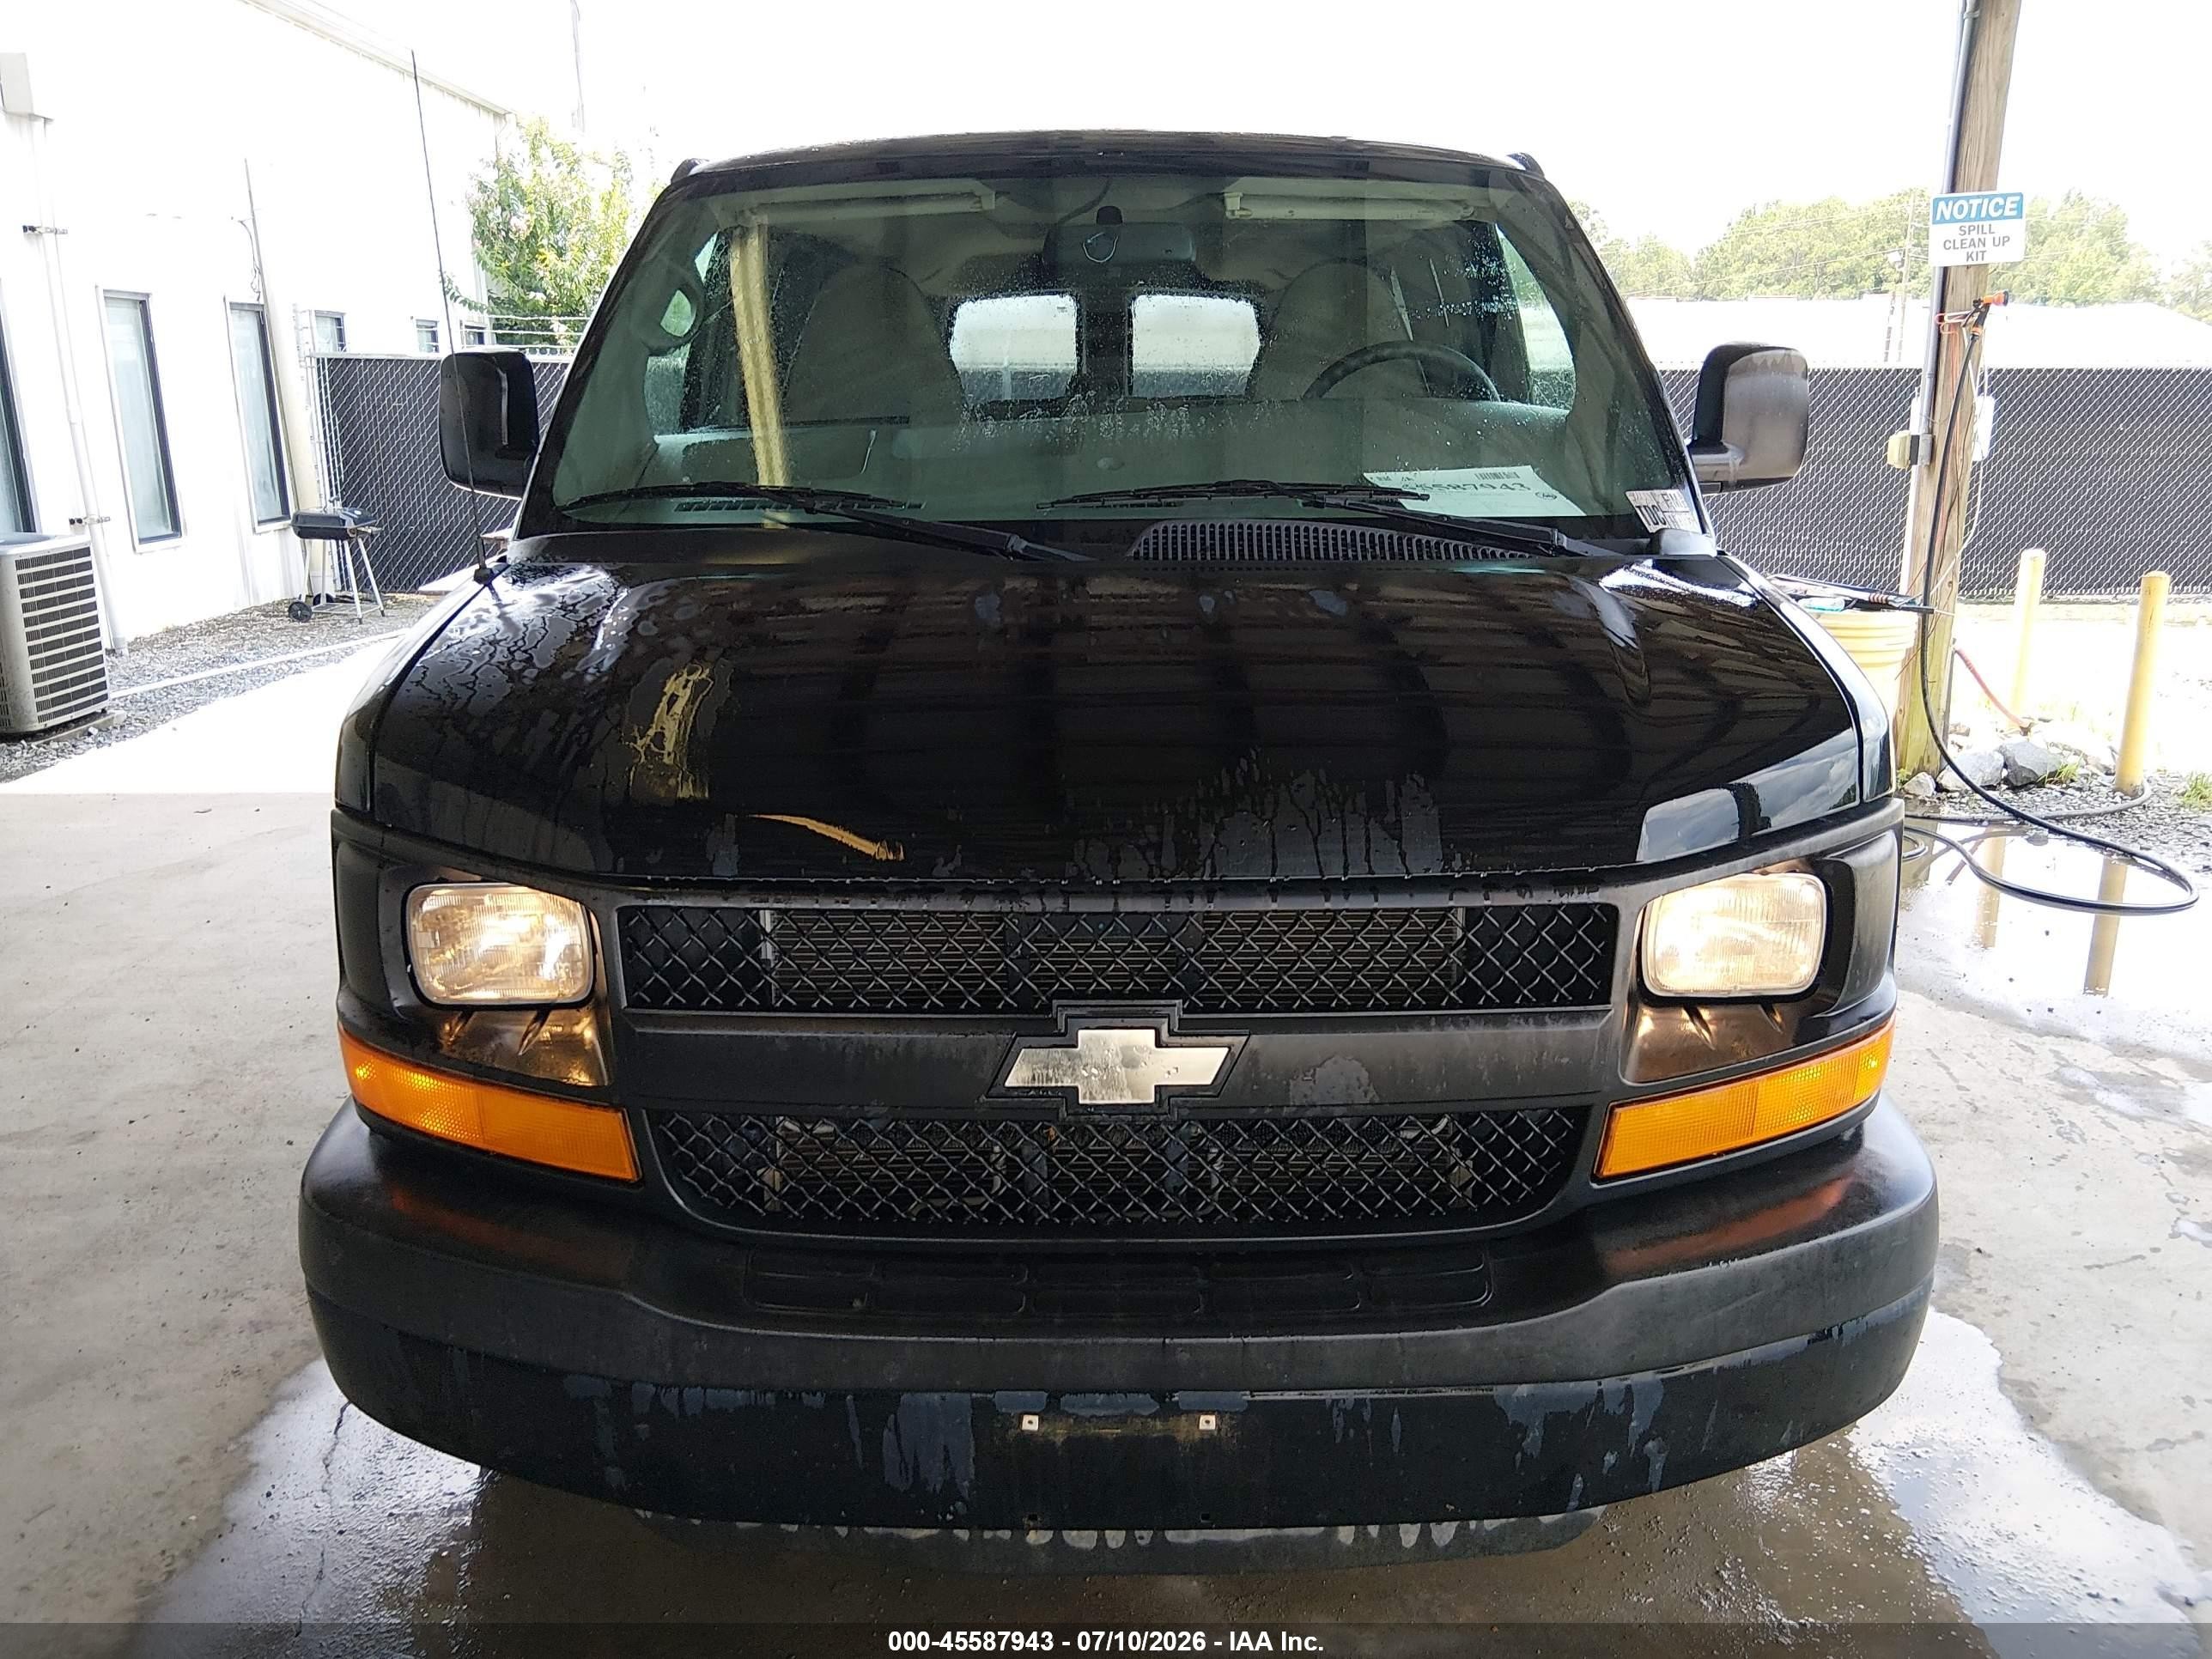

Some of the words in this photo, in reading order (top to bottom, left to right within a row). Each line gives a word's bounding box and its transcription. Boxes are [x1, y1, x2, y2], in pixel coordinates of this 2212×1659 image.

[1936, 196, 2021, 221] NOTICE
[1959, 223, 1996, 236] SPILL
[1943, 237, 1987, 251] CLEAN
[1992, 235, 2010, 247] UP
[1966, 250, 1987, 262] KIT
